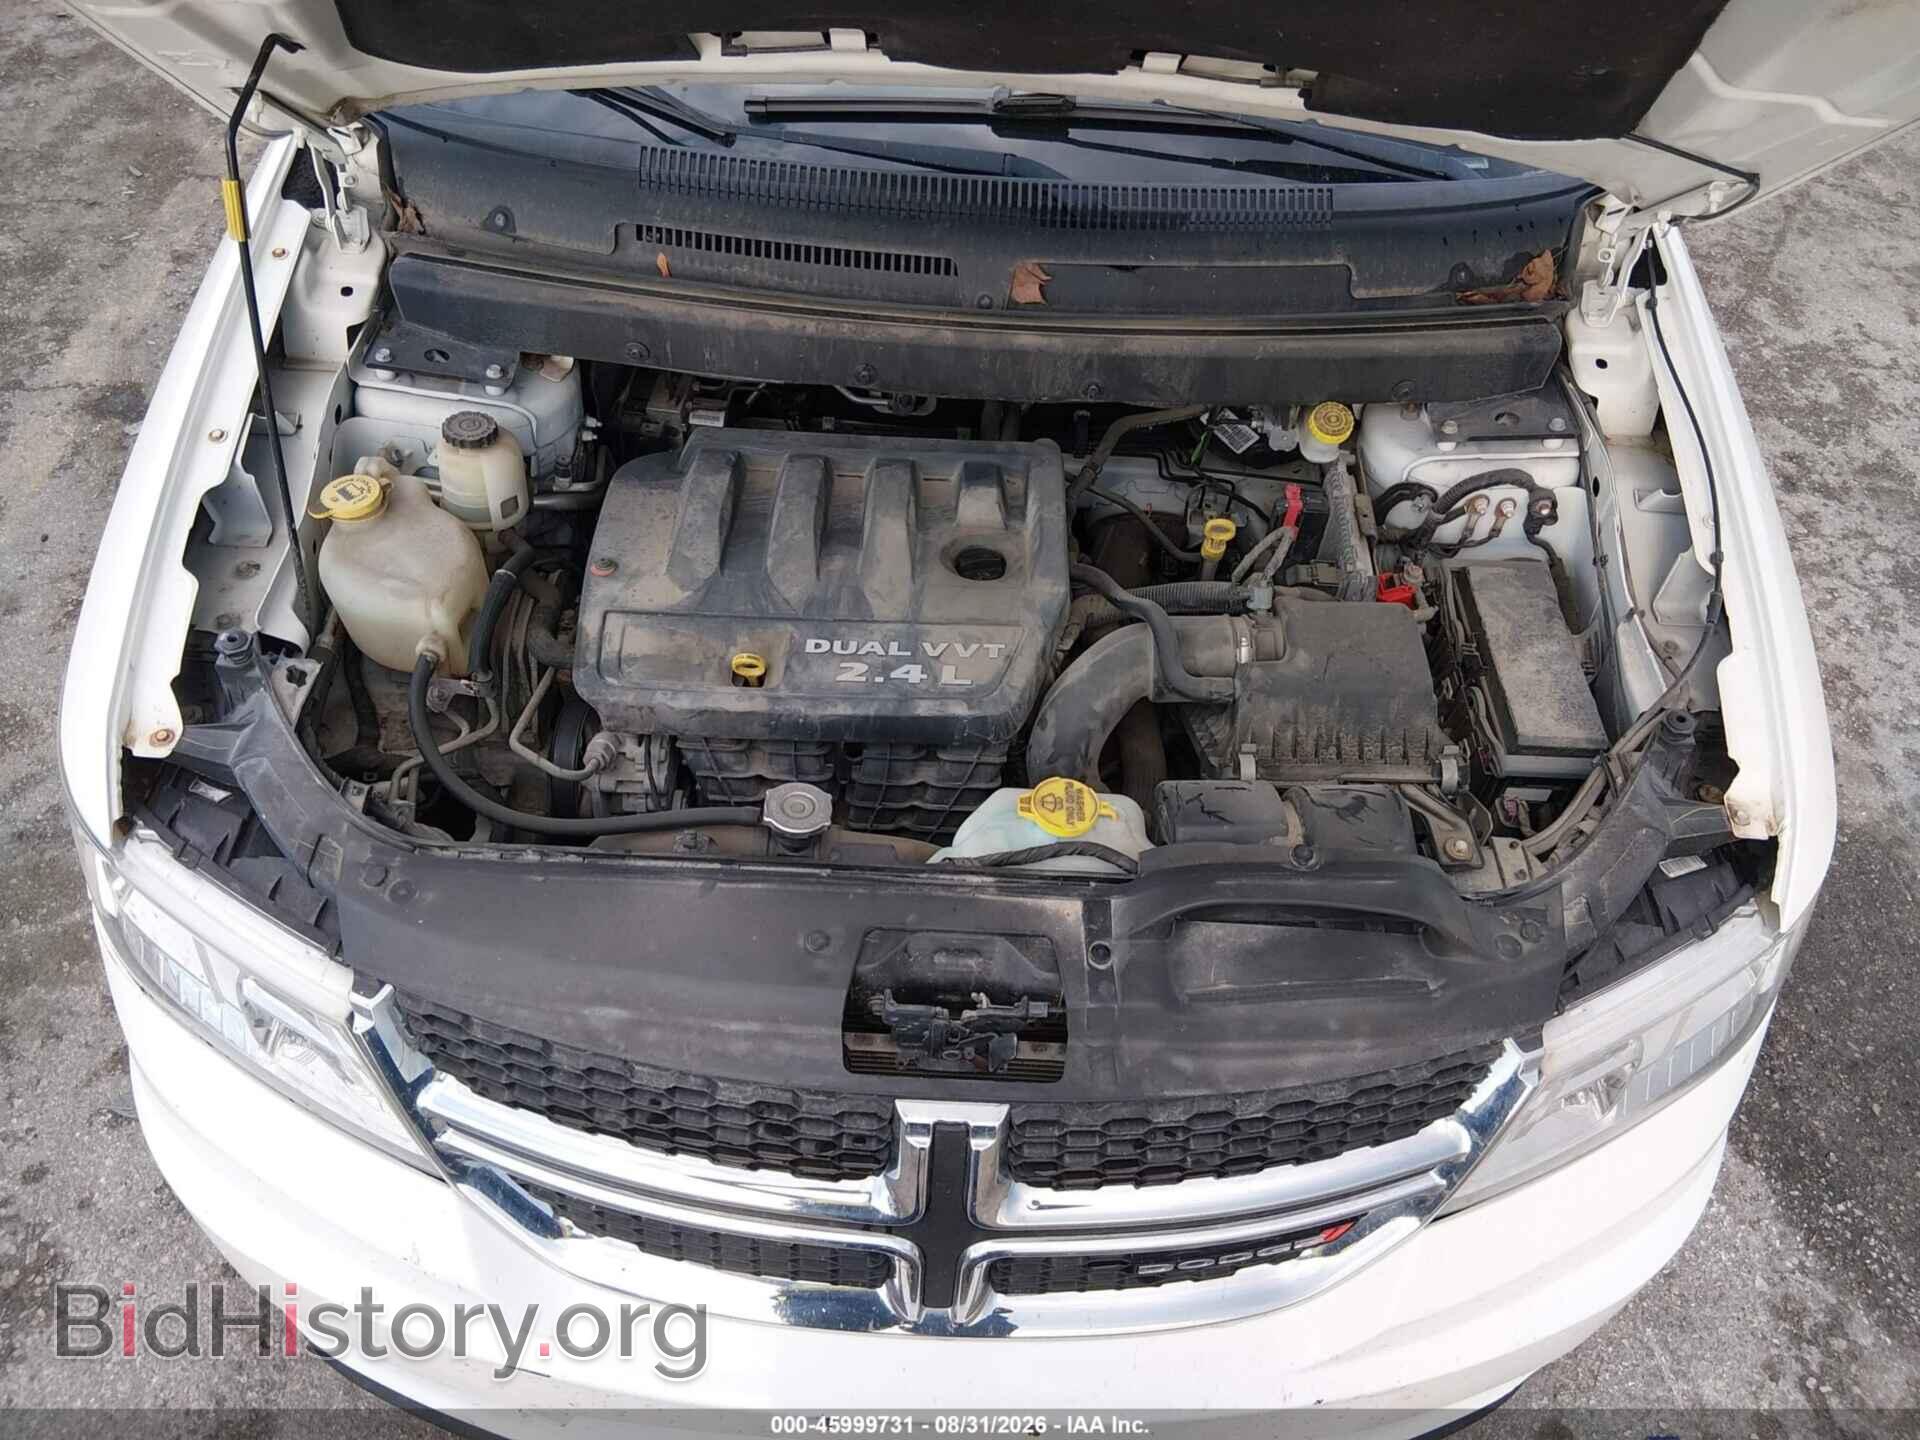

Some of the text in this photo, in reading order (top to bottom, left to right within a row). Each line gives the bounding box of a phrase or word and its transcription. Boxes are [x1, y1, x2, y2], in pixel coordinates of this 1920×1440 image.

[804, 638, 1006, 659] DUAL VVT
[835, 661, 973, 685] 2.4 L
